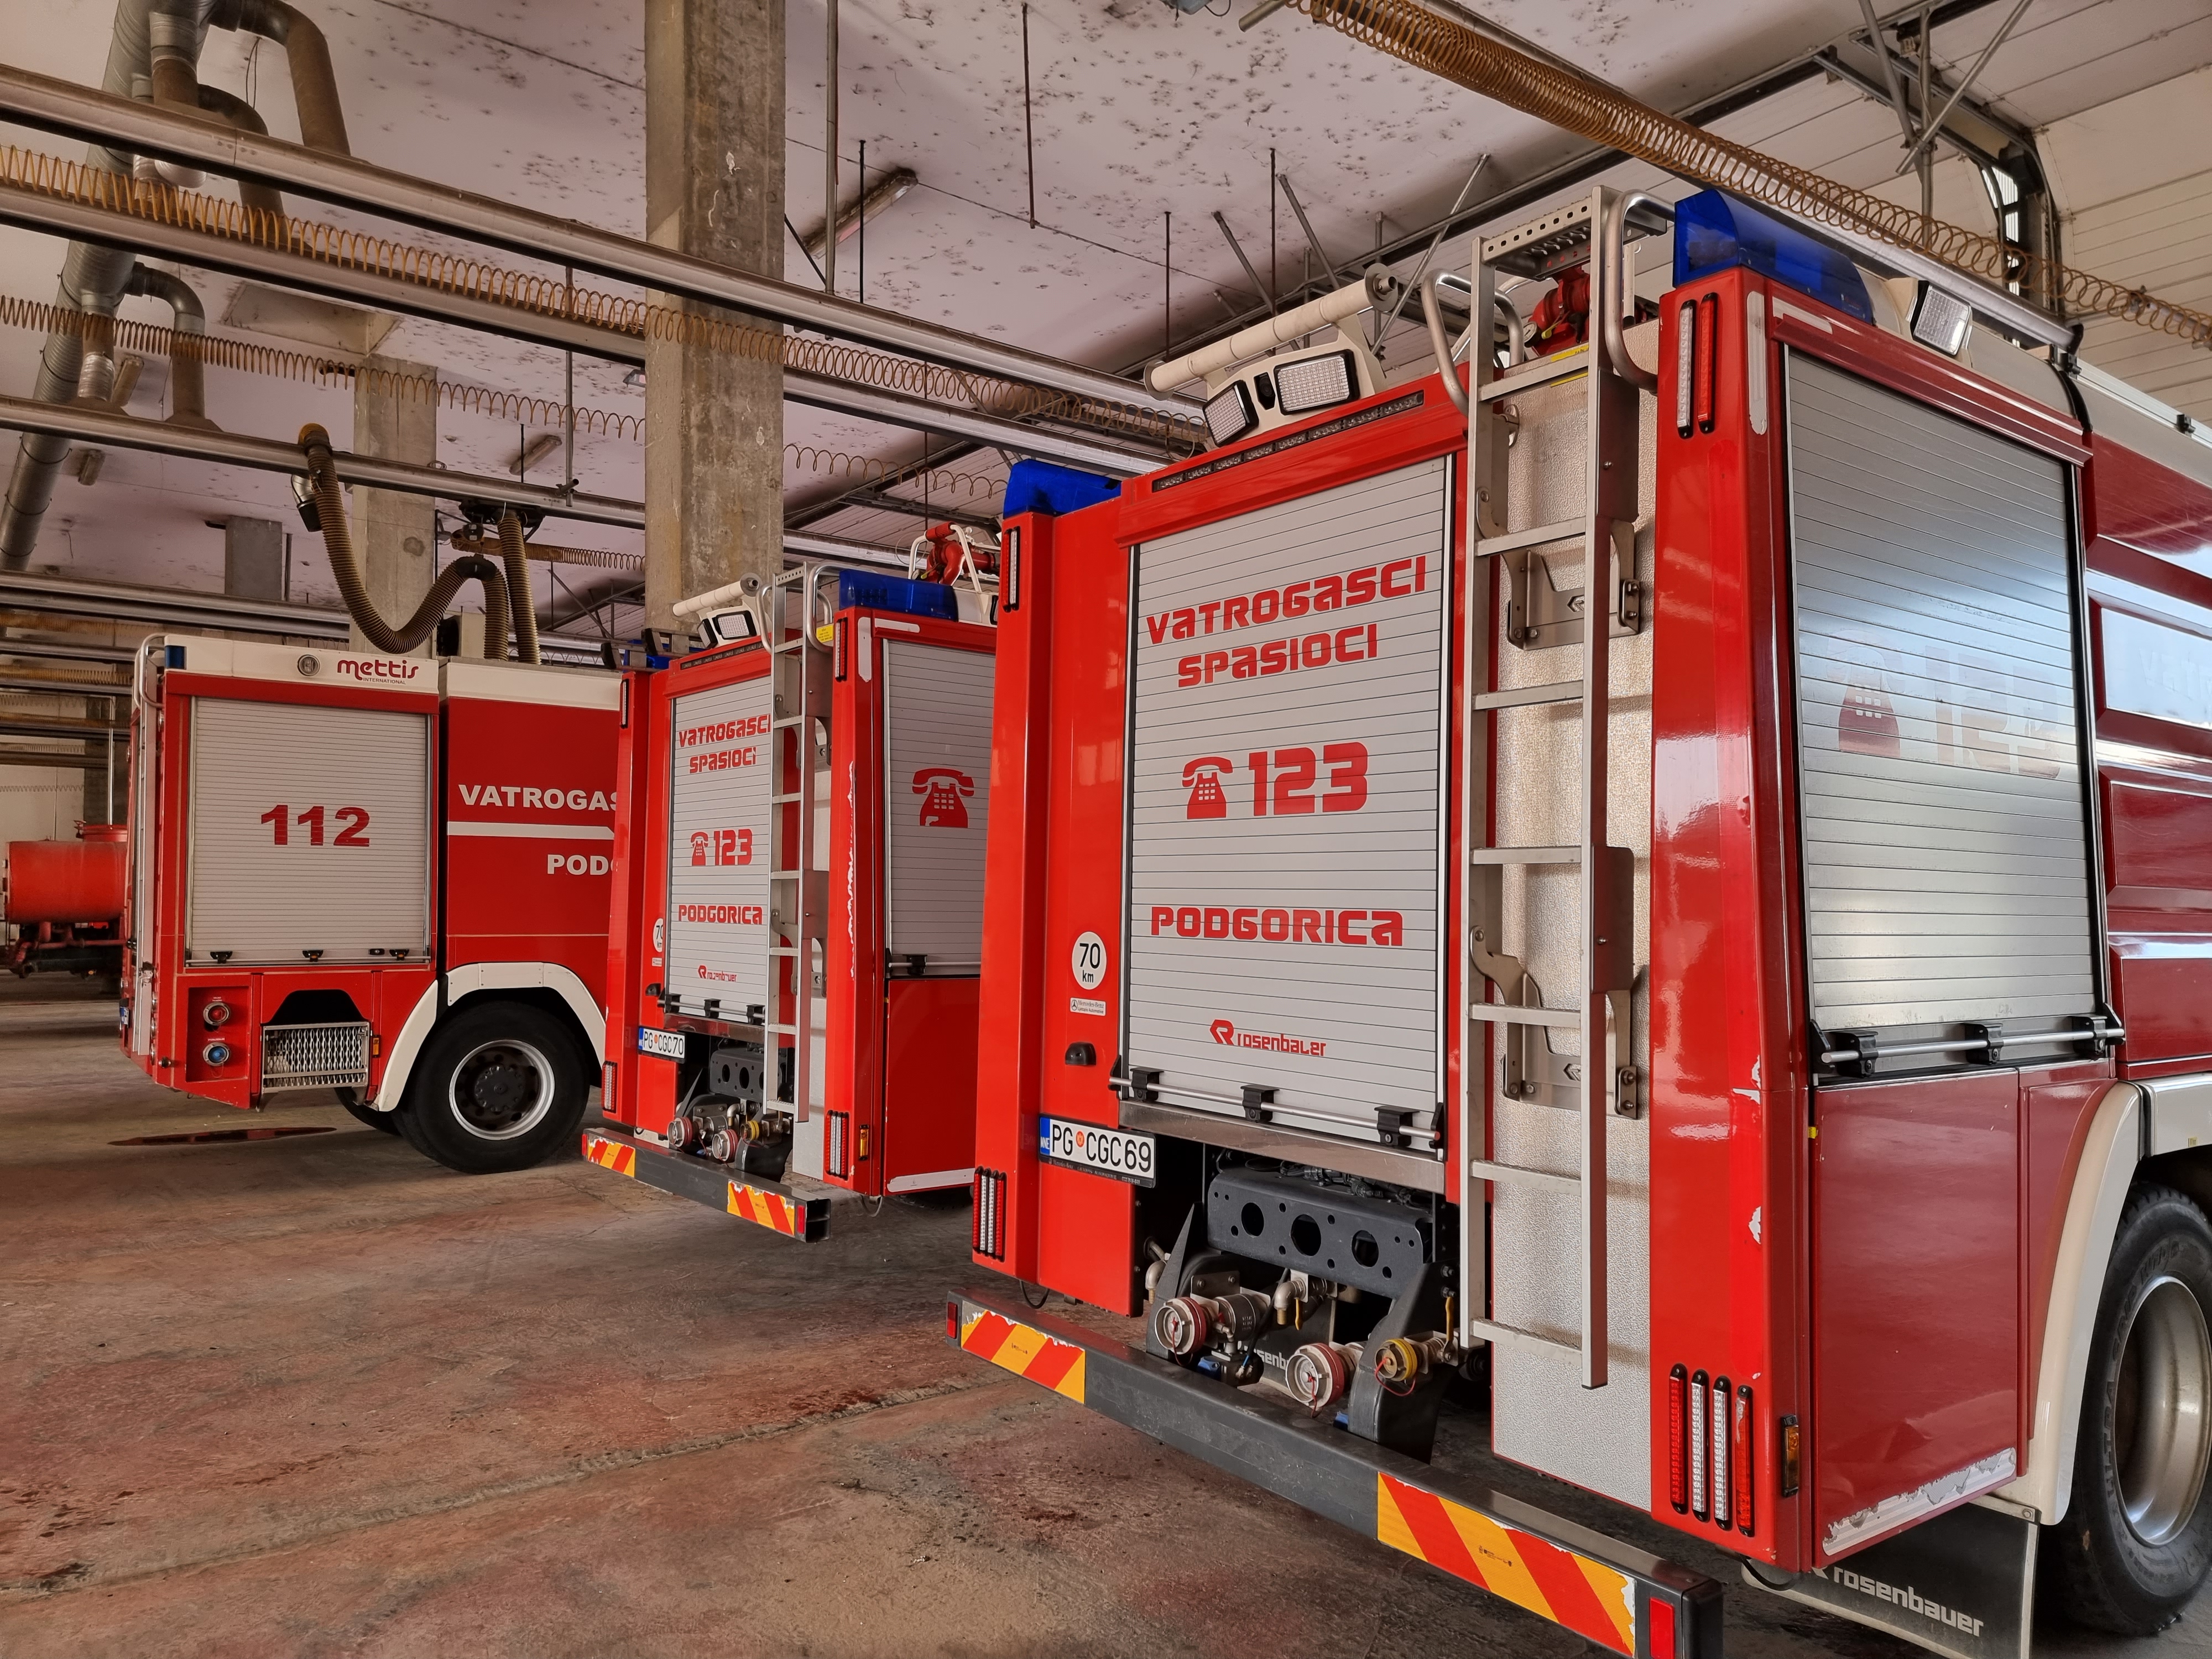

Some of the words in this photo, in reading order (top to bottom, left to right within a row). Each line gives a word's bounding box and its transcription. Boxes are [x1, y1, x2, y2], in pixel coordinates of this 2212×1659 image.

[337, 660, 419, 681] mettis
[1249, 742, 1368, 816] 123
[261, 805, 370, 847] 112
[714, 829, 753, 866] 123
[547, 854, 614, 876] POD
[1079, 943, 1100, 969] 70
[1082, 969, 1094, 983] km
[643, 1031, 653, 1050] PG
[1040, 1136, 1050, 1150] MNE
[1052, 1124, 1073, 1156] PG
[1834, 1566, 1984, 1637] rosenbauer
